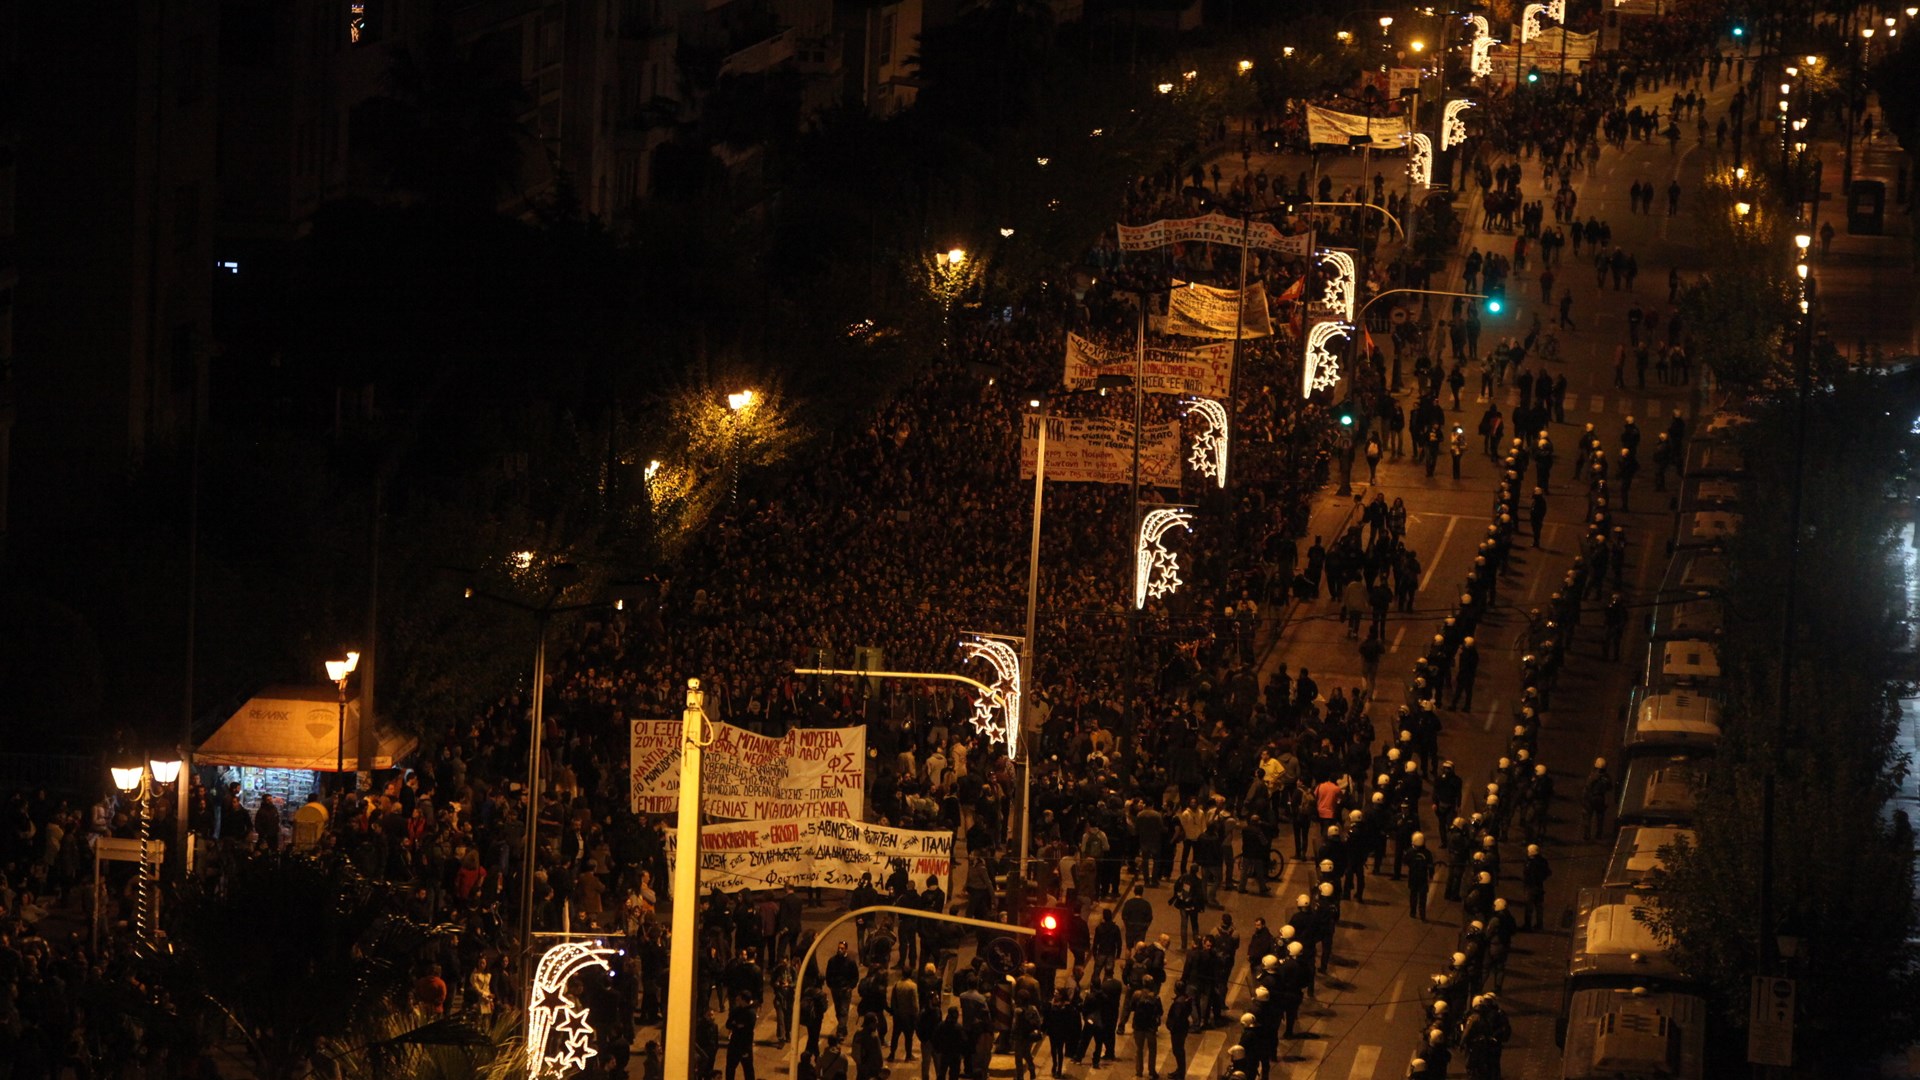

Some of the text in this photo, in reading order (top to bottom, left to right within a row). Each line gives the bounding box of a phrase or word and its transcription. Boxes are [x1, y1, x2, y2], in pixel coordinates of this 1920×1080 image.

[248, 710, 289, 721] RE/MAX
[634, 721, 648, 735] ΟΙ
[800, 730, 843, 748] ΜΟΥΣΕΙΑ
[798, 746, 829, 761] ΛΑΟΥ
[807, 823, 816, 835] 5
[921, 836, 953, 855] ΙΤΑΛΙΑ
